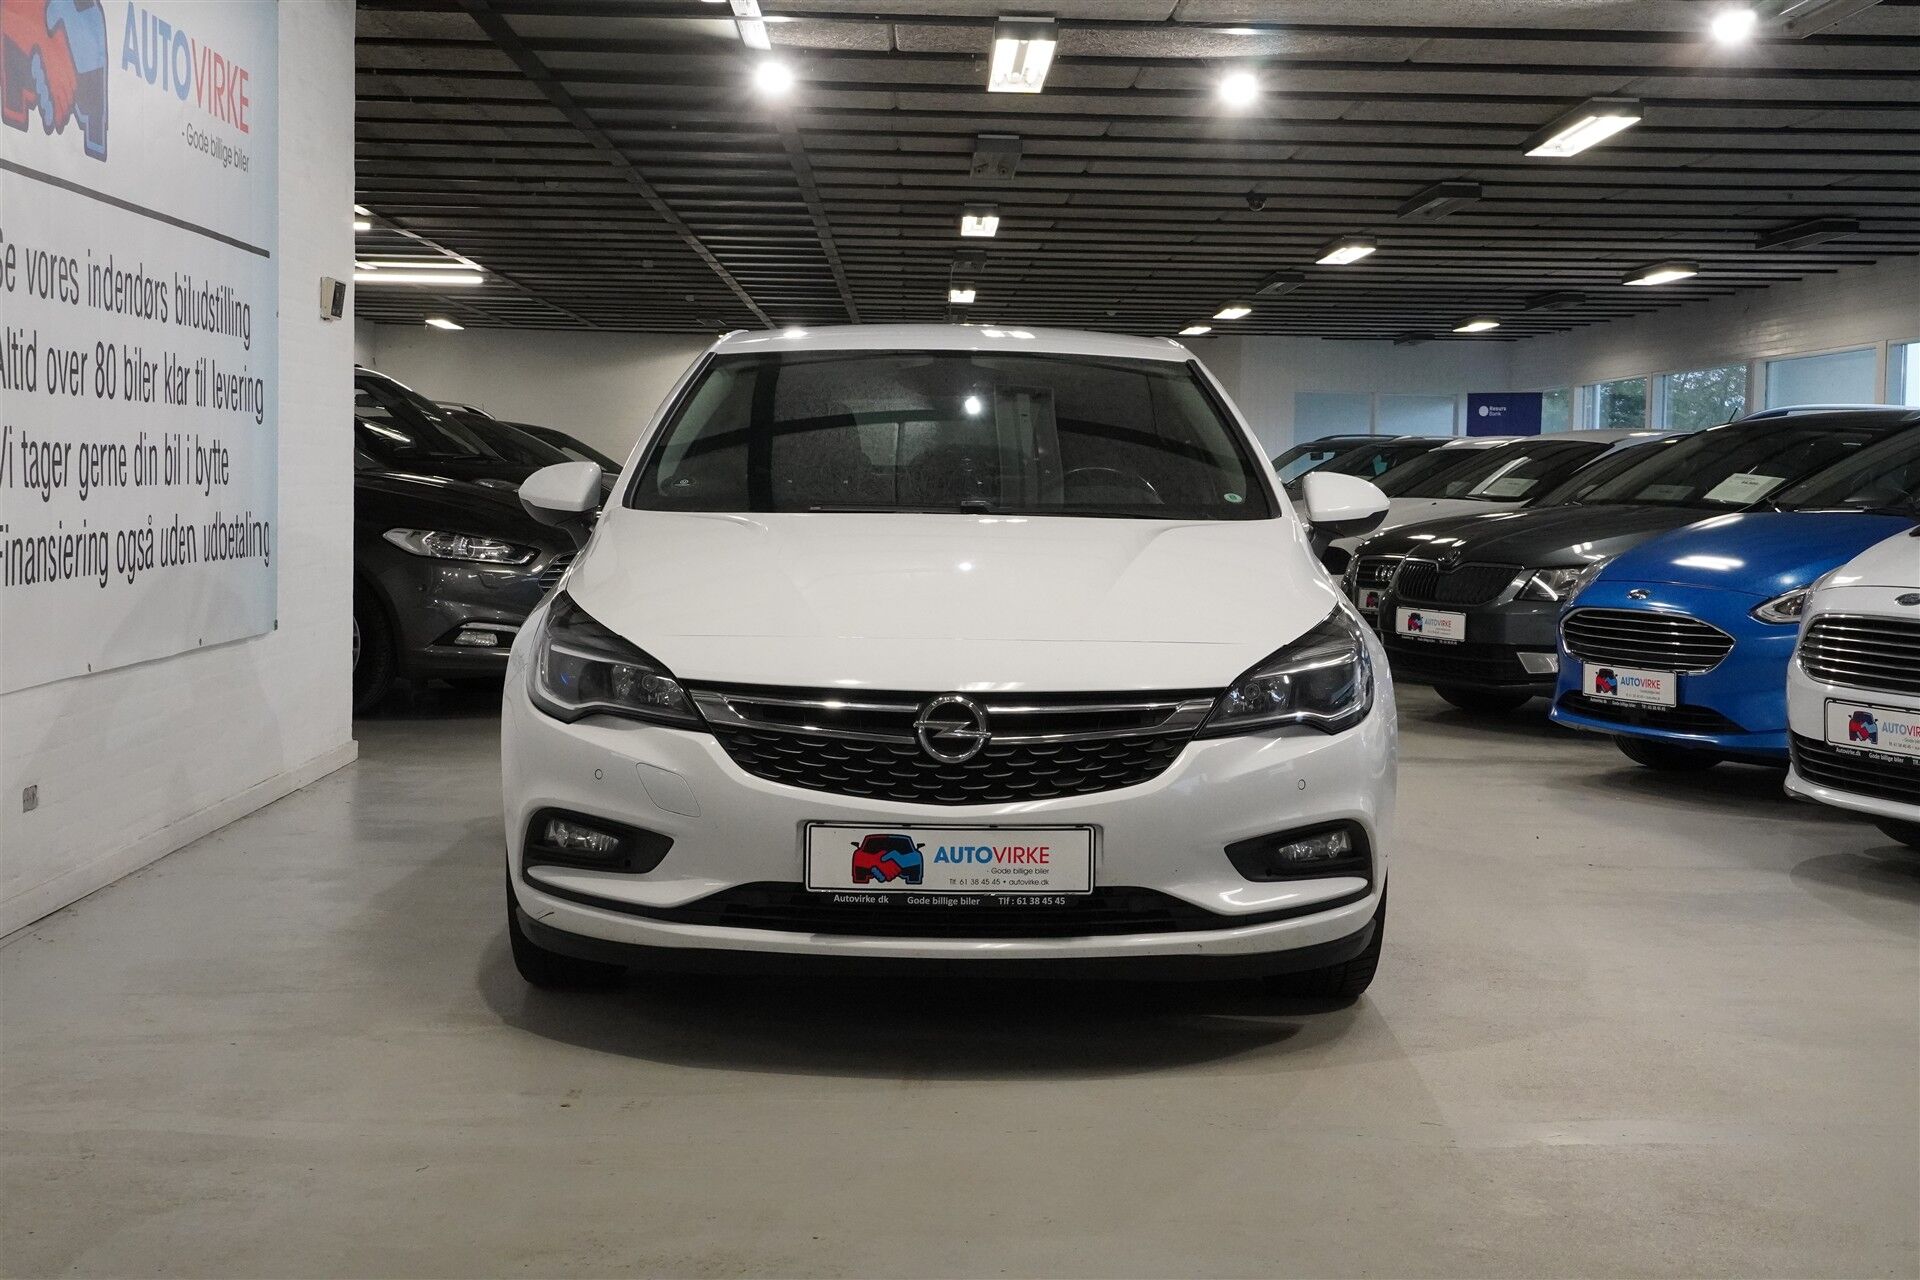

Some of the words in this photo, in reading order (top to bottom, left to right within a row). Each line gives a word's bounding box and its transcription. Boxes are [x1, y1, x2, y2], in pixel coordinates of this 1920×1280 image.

[121, 1, 249, 134] AUTOVIRKE
[187, 123, 209, 153] Gode
[210, 132, 232, 168] billige
[233, 145, 249, 173] biler
[0, 227, 16, 292] e
[26, 248, 79, 305] vores
[87, 249, 168, 323] indendørs
[175, 272, 251, 350] biludstilling
[47, 347, 87, 396] over
[95, 341, 116, 399] 80
[124, 345, 158, 402] biler
[164, 351, 190, 405] klar
[195, 357, 206, 407] til
[212, 359, 264, 425] levering
[21, 430, 71, 502] tager
[79, 443, 127, 501] gerne
[134, 431, 158, 486] din
[164, 432, 180, 486] bil
[186, 434, 190, 485] i
[195, 433, 229, 496] bytte
[116, 514, 154, 585] også
[160, 513, 197, 568] uden
[203, 511, 270, 567] udbetaling
[1620, 676, 1661, 690] AUTOVIRKE
[933, 846, 1050, 864] AUTOVIRKE
[907, 896, 931, 905] Gode
[932, 896, 959, 907] billige
[960, 897, 981, 905] biler
[1016, 897, 1028, 905] 61
[1029, 897, 1040, 905] 38
[1041, 897, 1053, 905] 45
[1054, 897, 1066, 905] 45
